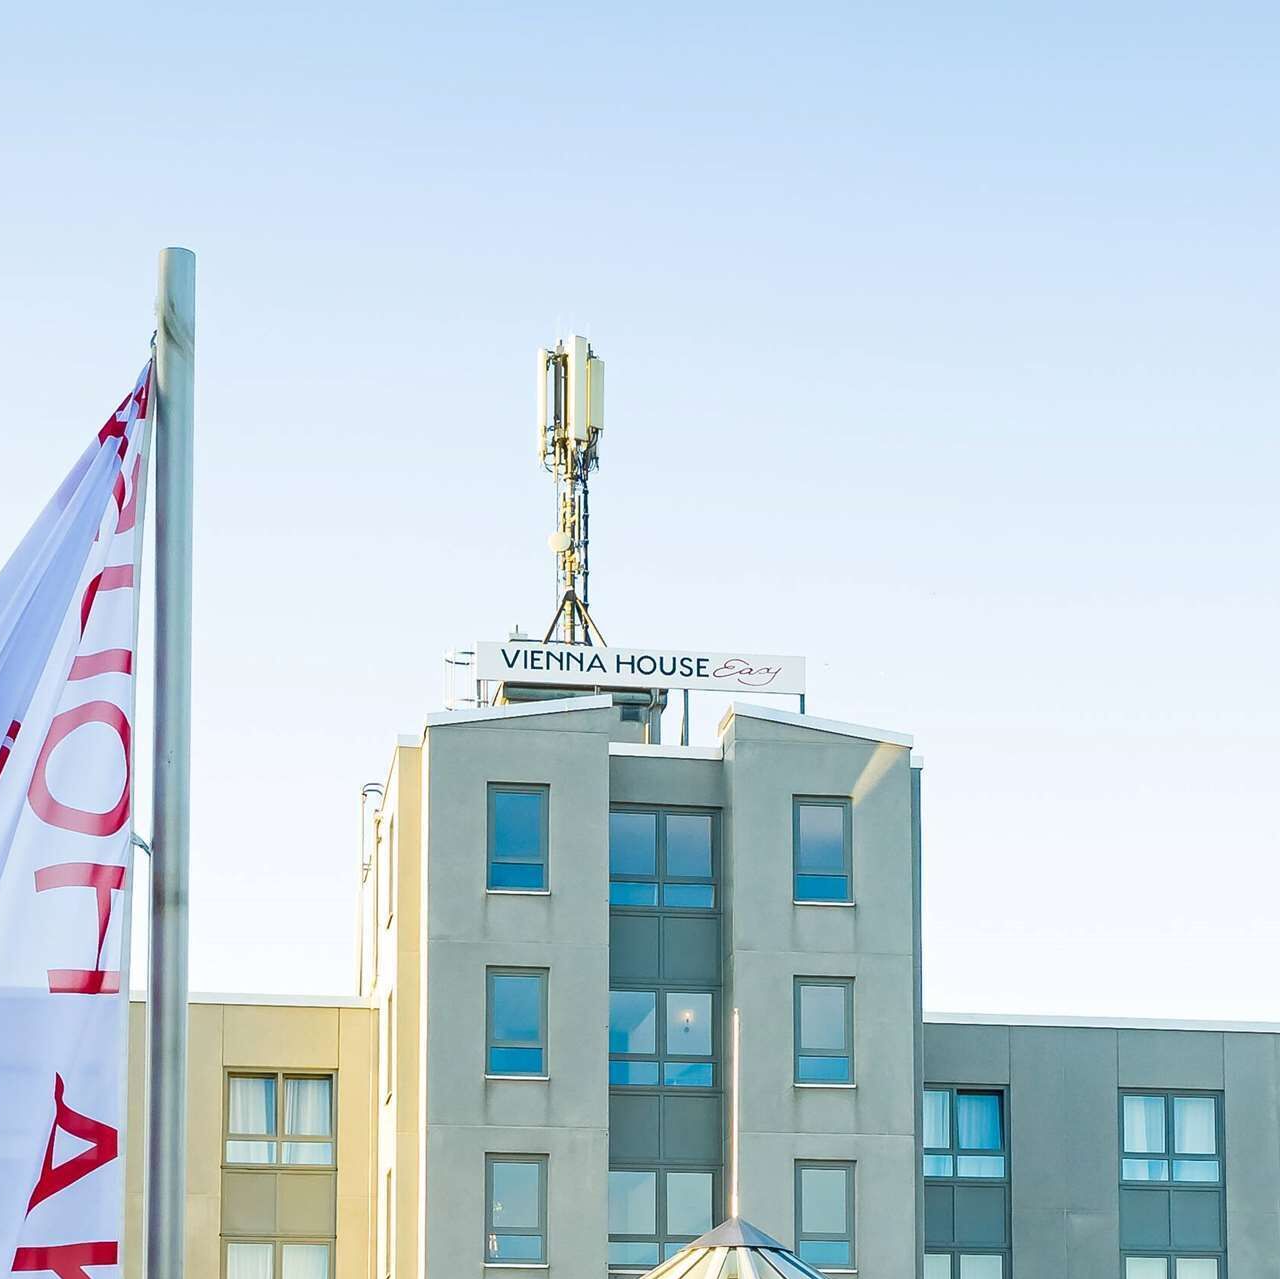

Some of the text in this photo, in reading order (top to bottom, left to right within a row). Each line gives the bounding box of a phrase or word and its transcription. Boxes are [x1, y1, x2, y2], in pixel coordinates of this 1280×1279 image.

[501, 648, 783, 686] VIENNA HOUSE Easy
